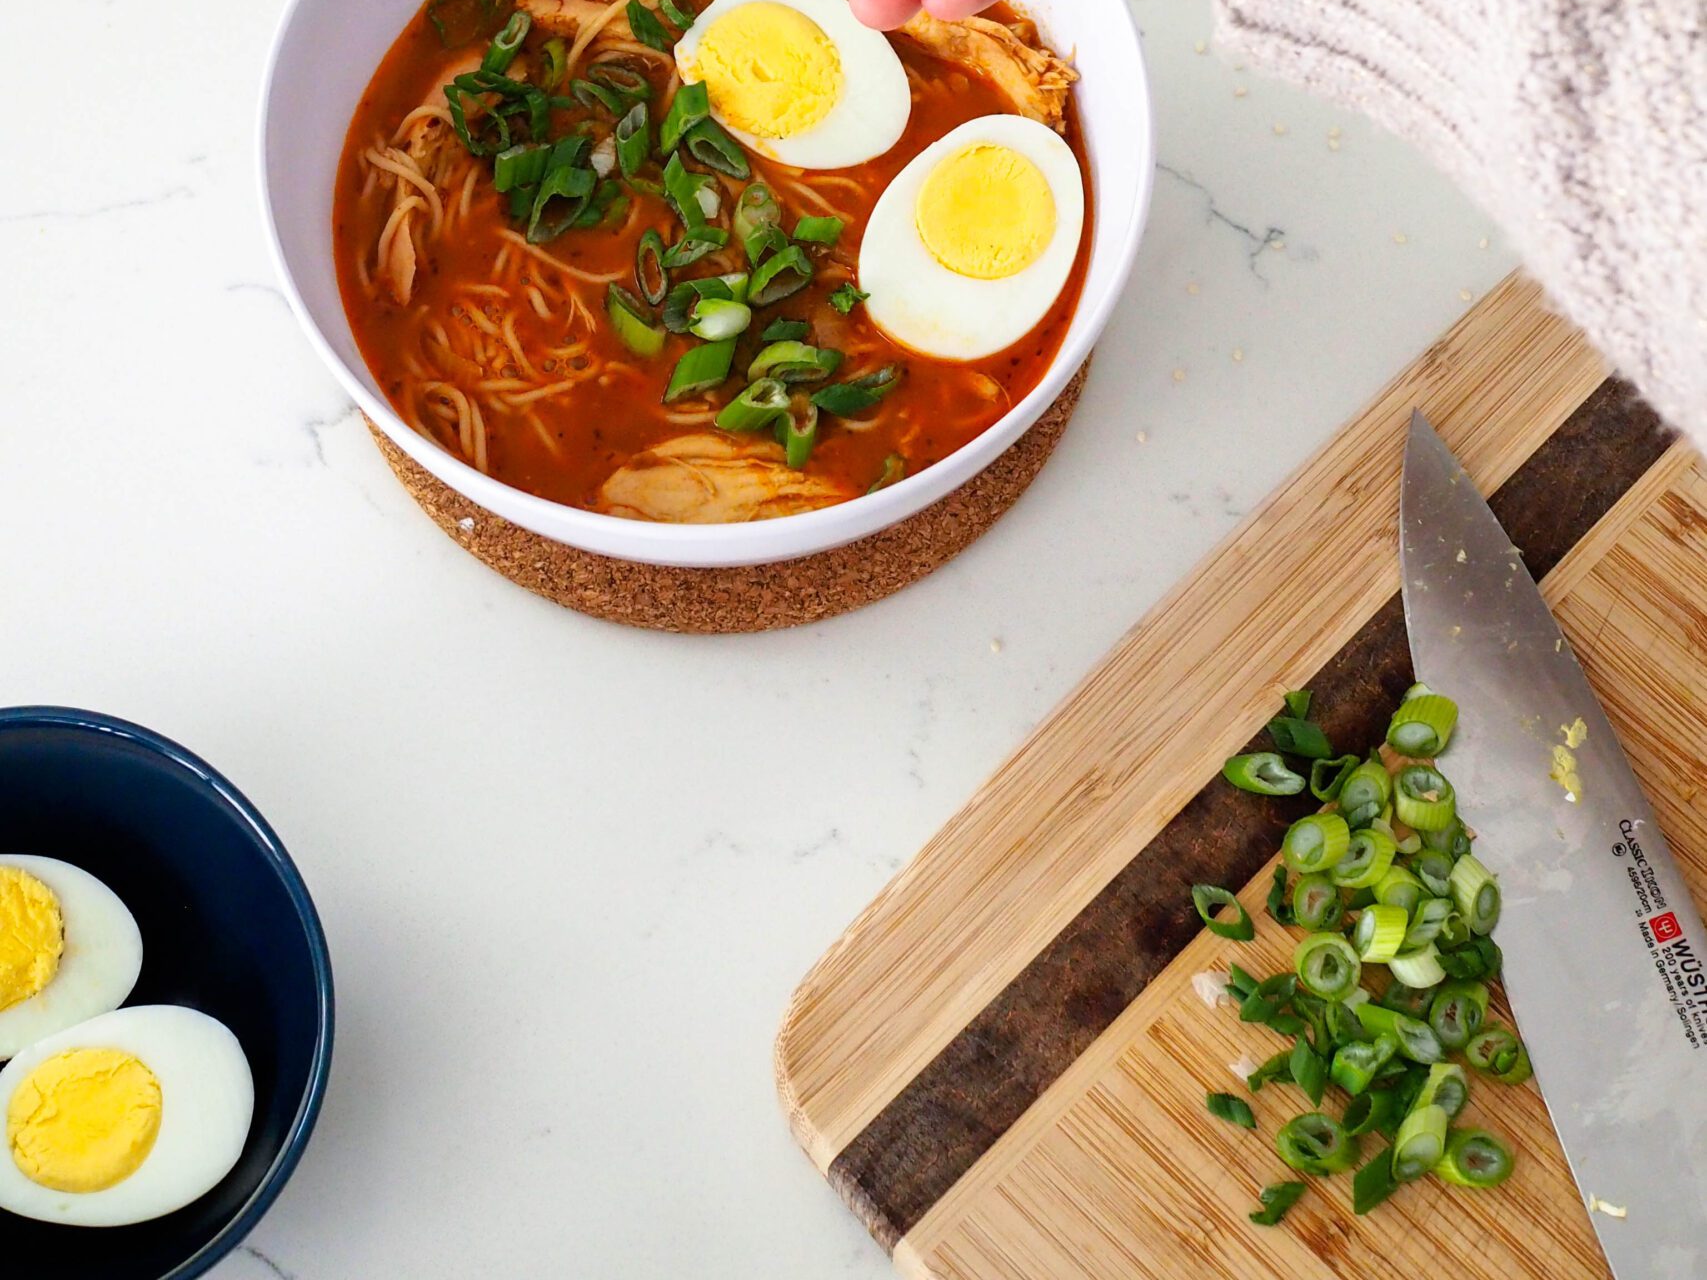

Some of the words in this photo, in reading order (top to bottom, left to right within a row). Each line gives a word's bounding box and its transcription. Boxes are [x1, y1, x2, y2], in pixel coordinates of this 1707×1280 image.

[1619, 819, 1648, 868] CLASSIC
[1638, 921, 1655, 948] Made
[1650, 948, 1659, 959] in
[1662, 946, 1677, 966] 200
[1670, 968, 1689, 996] years
[1685, 999, 1697, 1009] of
